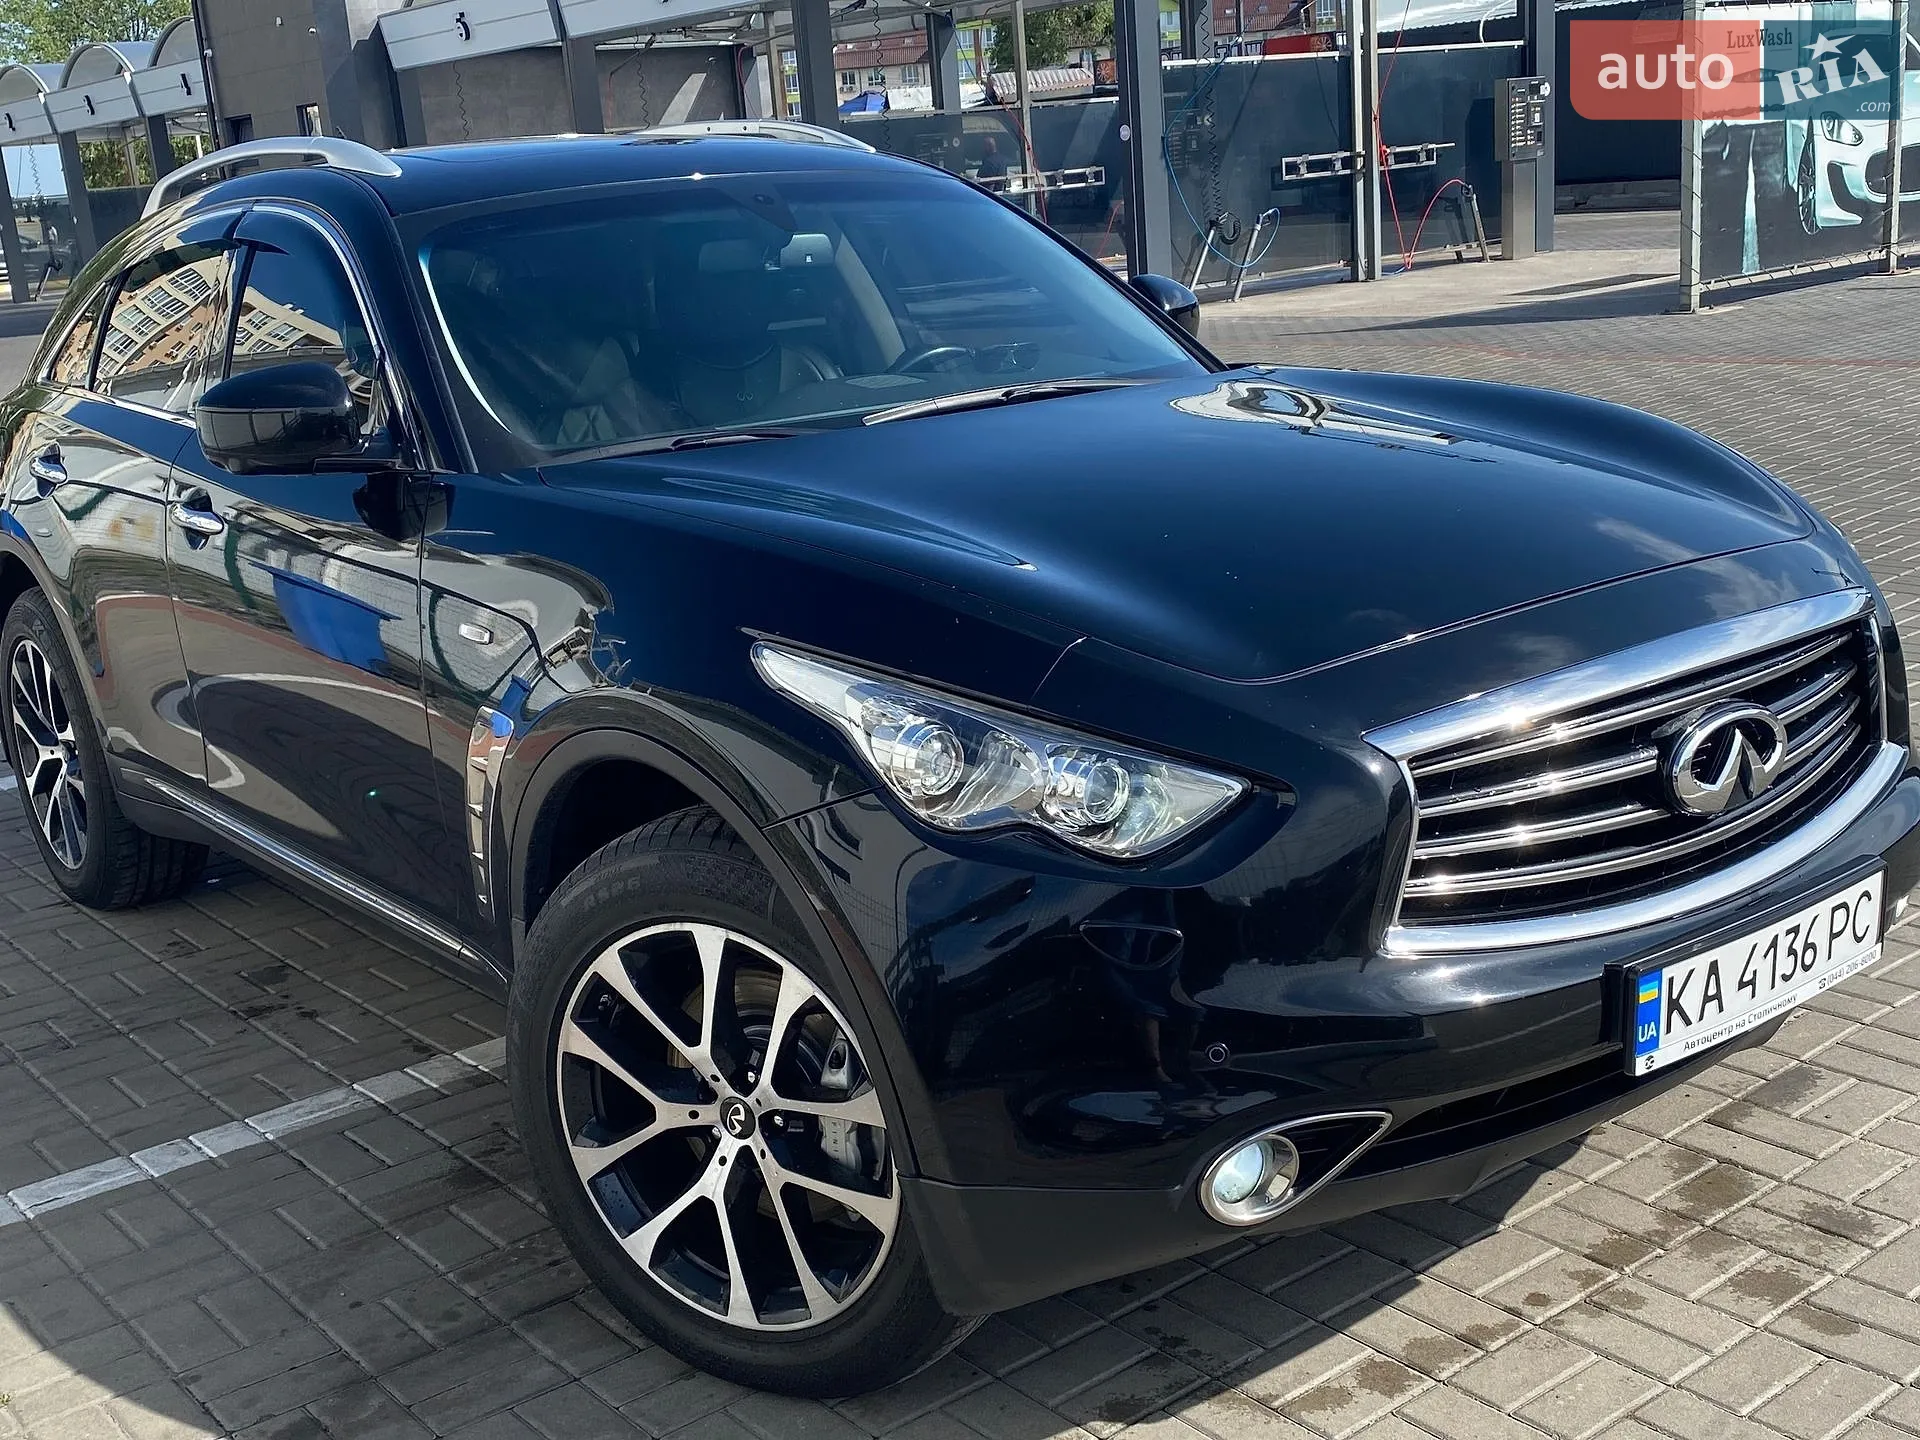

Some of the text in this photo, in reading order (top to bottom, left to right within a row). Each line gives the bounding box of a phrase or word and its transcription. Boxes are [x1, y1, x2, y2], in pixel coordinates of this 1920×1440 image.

[1726, 28, 1793, 49] LuxWash
[1665, 889, 1873, 1035] KA 4136 PC
[1638, 1021, 1657, 1043] UA
[1683, 993, 1798, 1051] Автоцентр на Столичному
